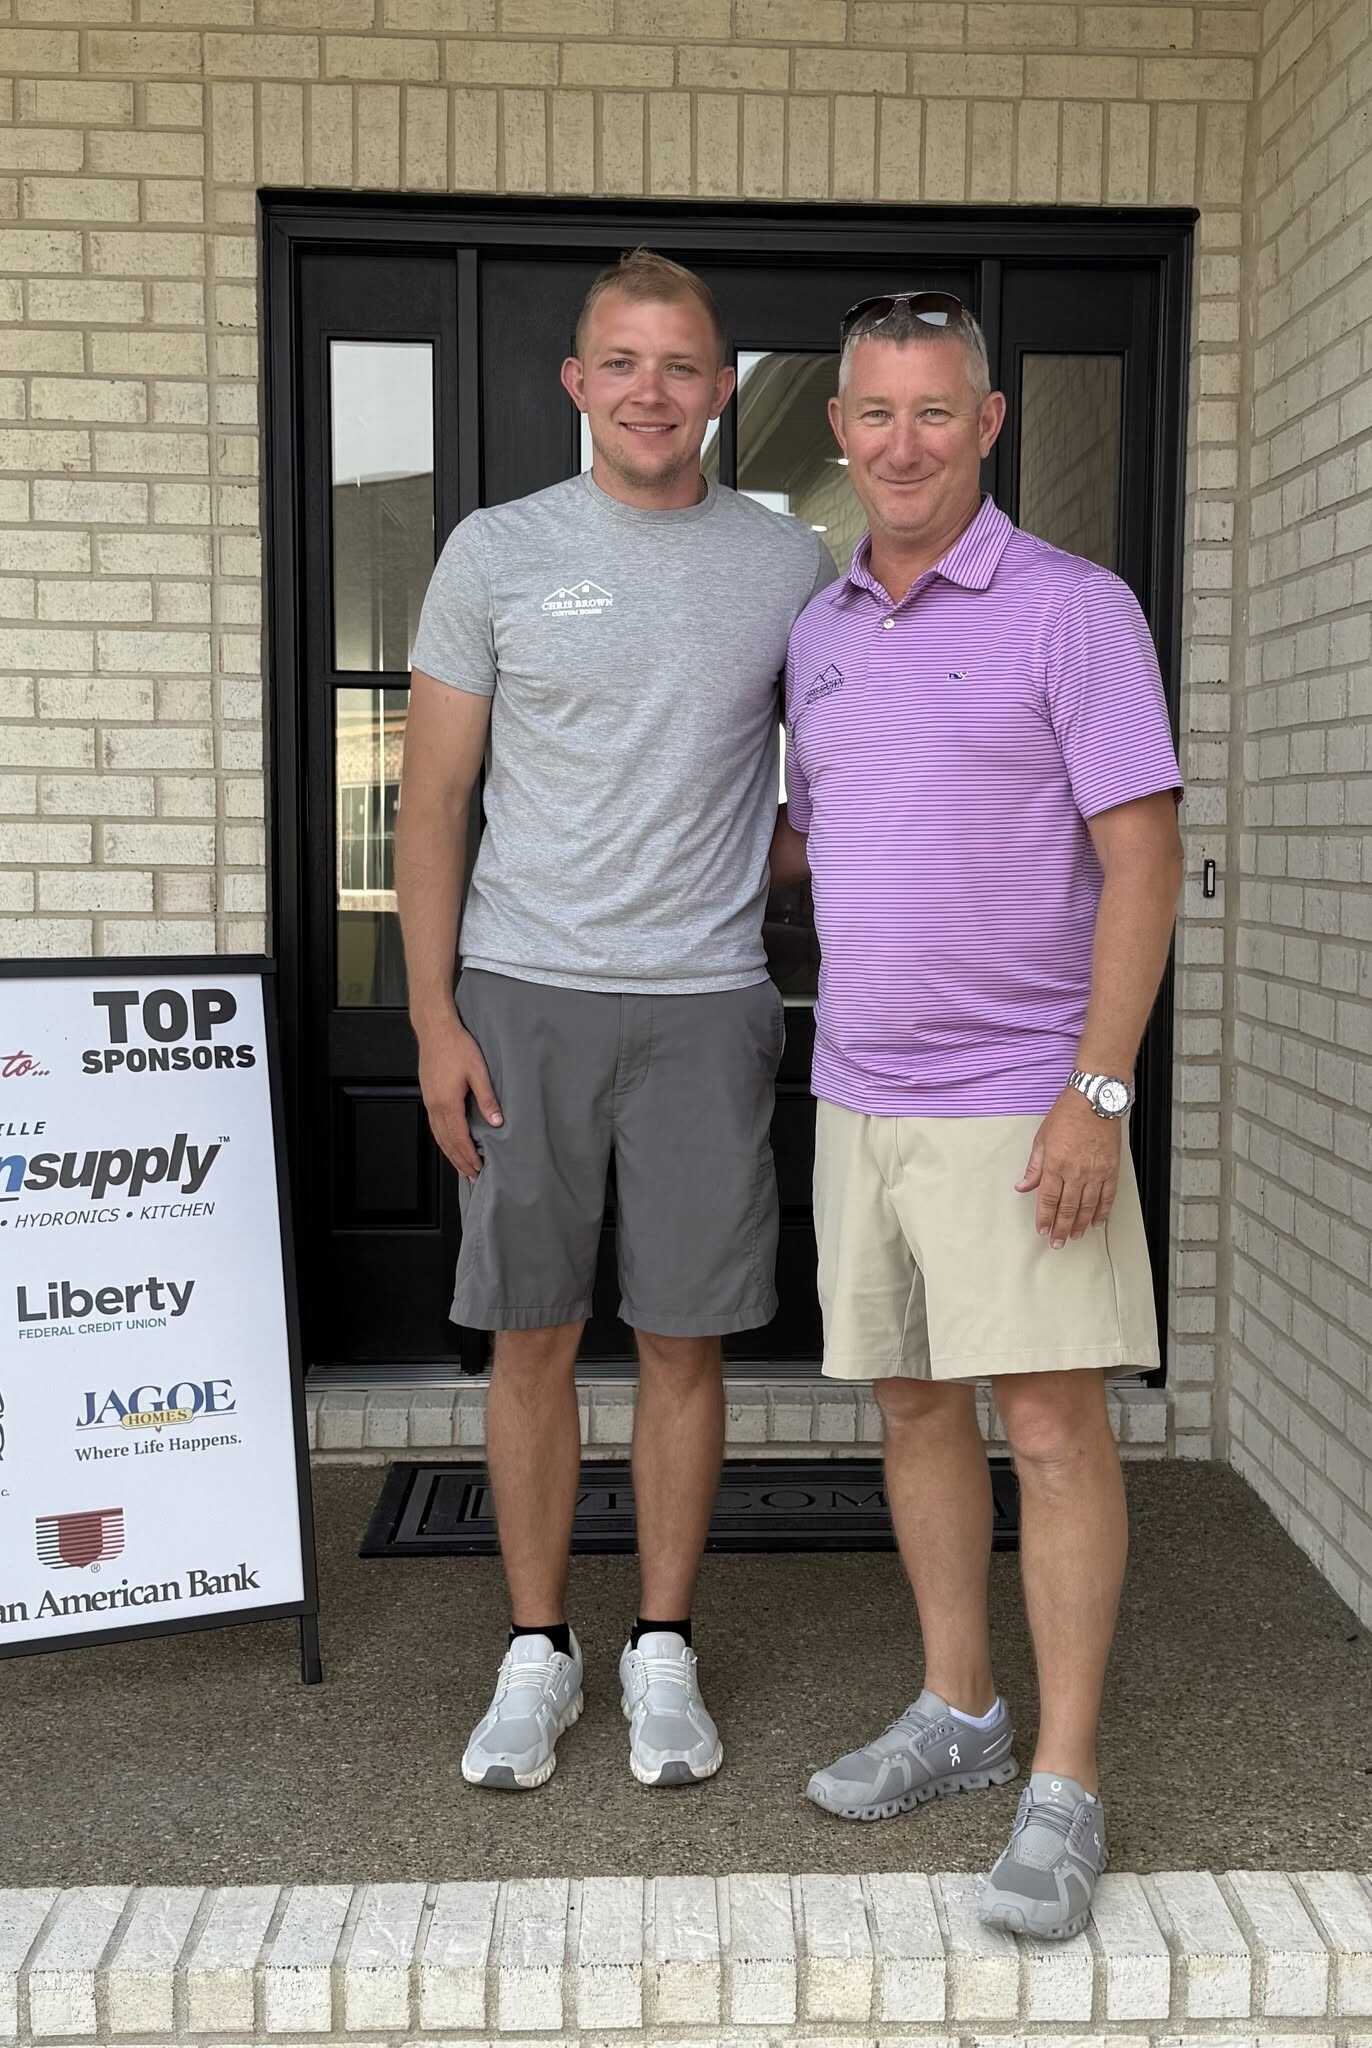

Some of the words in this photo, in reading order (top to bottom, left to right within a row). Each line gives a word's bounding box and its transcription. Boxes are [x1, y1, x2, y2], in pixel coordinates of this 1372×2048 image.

[542, 600, 573, 611] CHRIS
[575, 598, 613, 608] BROWN
[92, 988, 238, 1044] TOP
[81, 1044, 257, 1075] SPONSORS
[14, 1208, 120, 1229] HYDRONICS
[140, 1202, 216, 1220] KITCHEN
[16, 1276, 196, 1323] Liberty
[18, 1326, 75, 1340] FEDERAL
[78, 1320, 123, 1335] CREDIT
[126, 1316, 168, 1330] UNION
[75, 1379, 237, 1427] JAGOE
[127, 1409, 188, 1426] HOMES
[74, 1445, 130, 1462] Where
[134, 1440, 165, 1455] Life
[169, 1433, 242, 1452] Happens.
[34, 1578, 184, 1620] American
[185, 1562, 262, 1598] Bank
